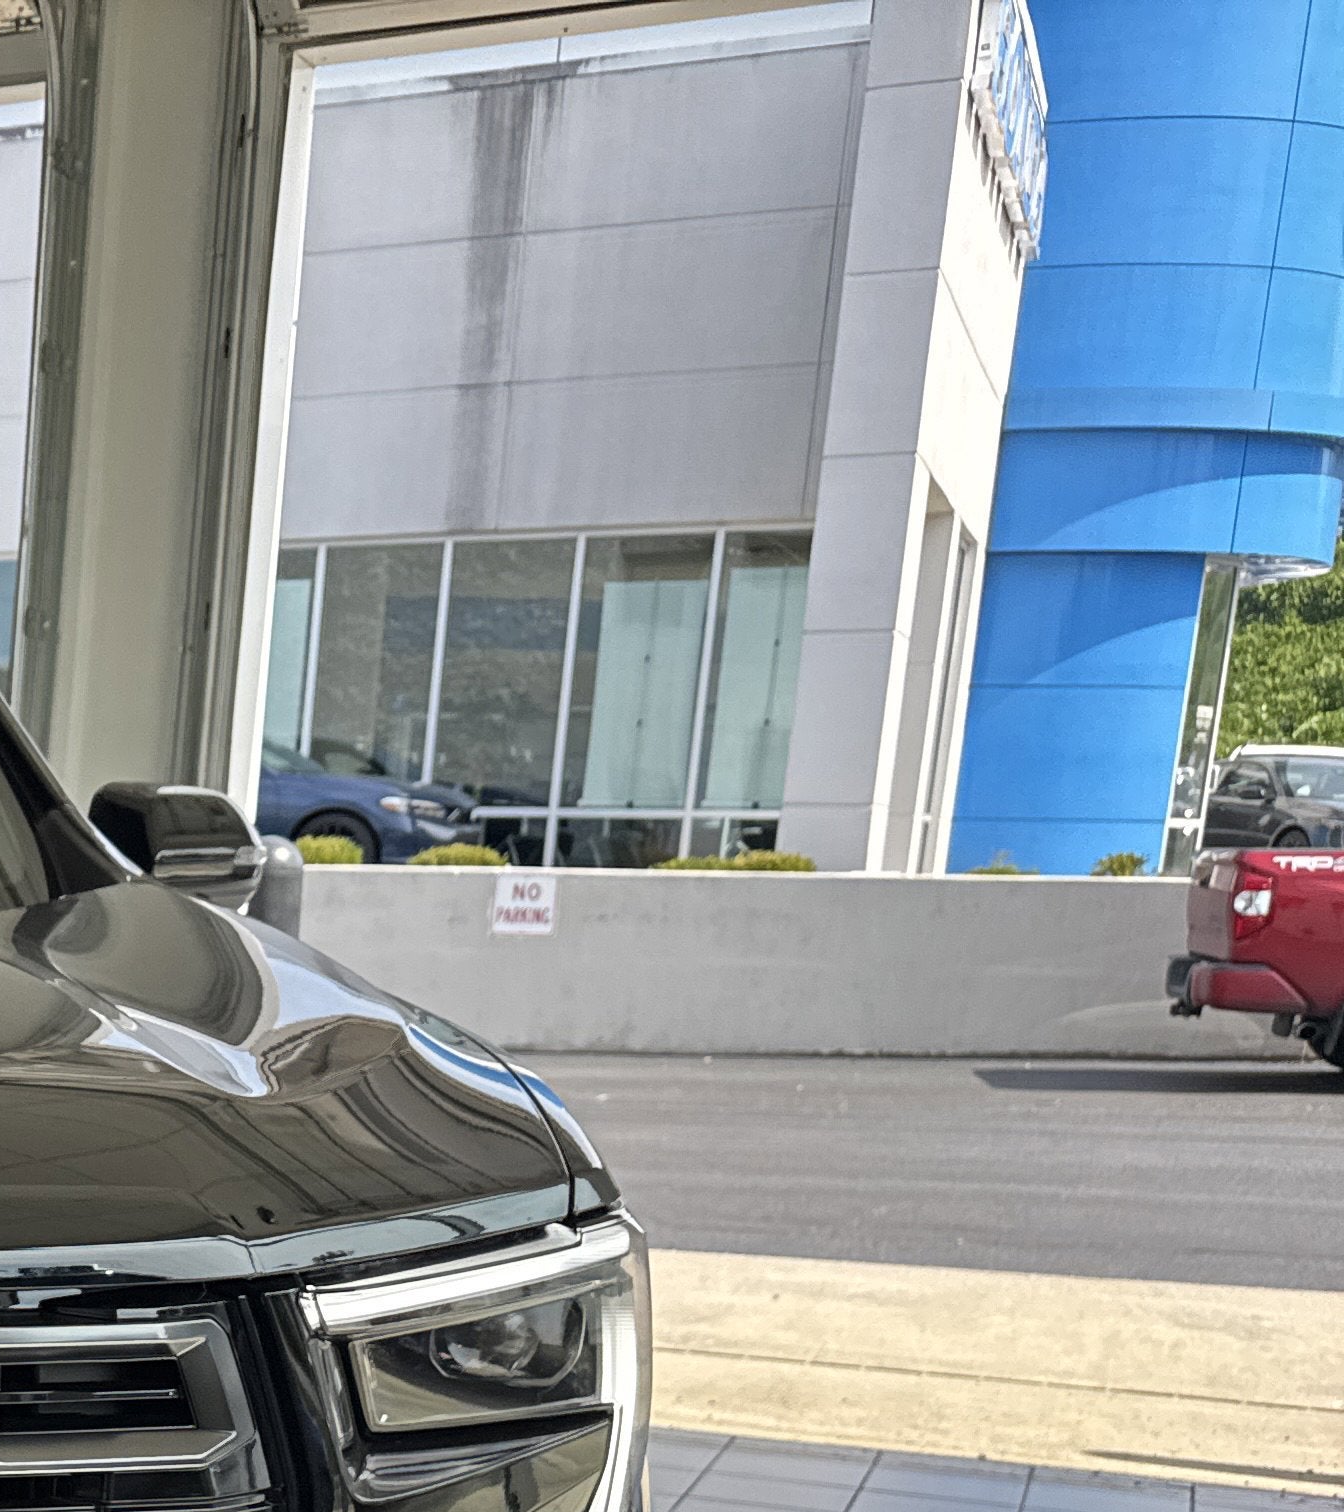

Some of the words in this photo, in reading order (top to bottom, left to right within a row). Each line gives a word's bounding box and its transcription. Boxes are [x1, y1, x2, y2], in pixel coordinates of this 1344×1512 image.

[1272, 855, 1333, 872] TRD
[513, 882, 542, 901] NO
[496, 905, 550, 924] PARKING
